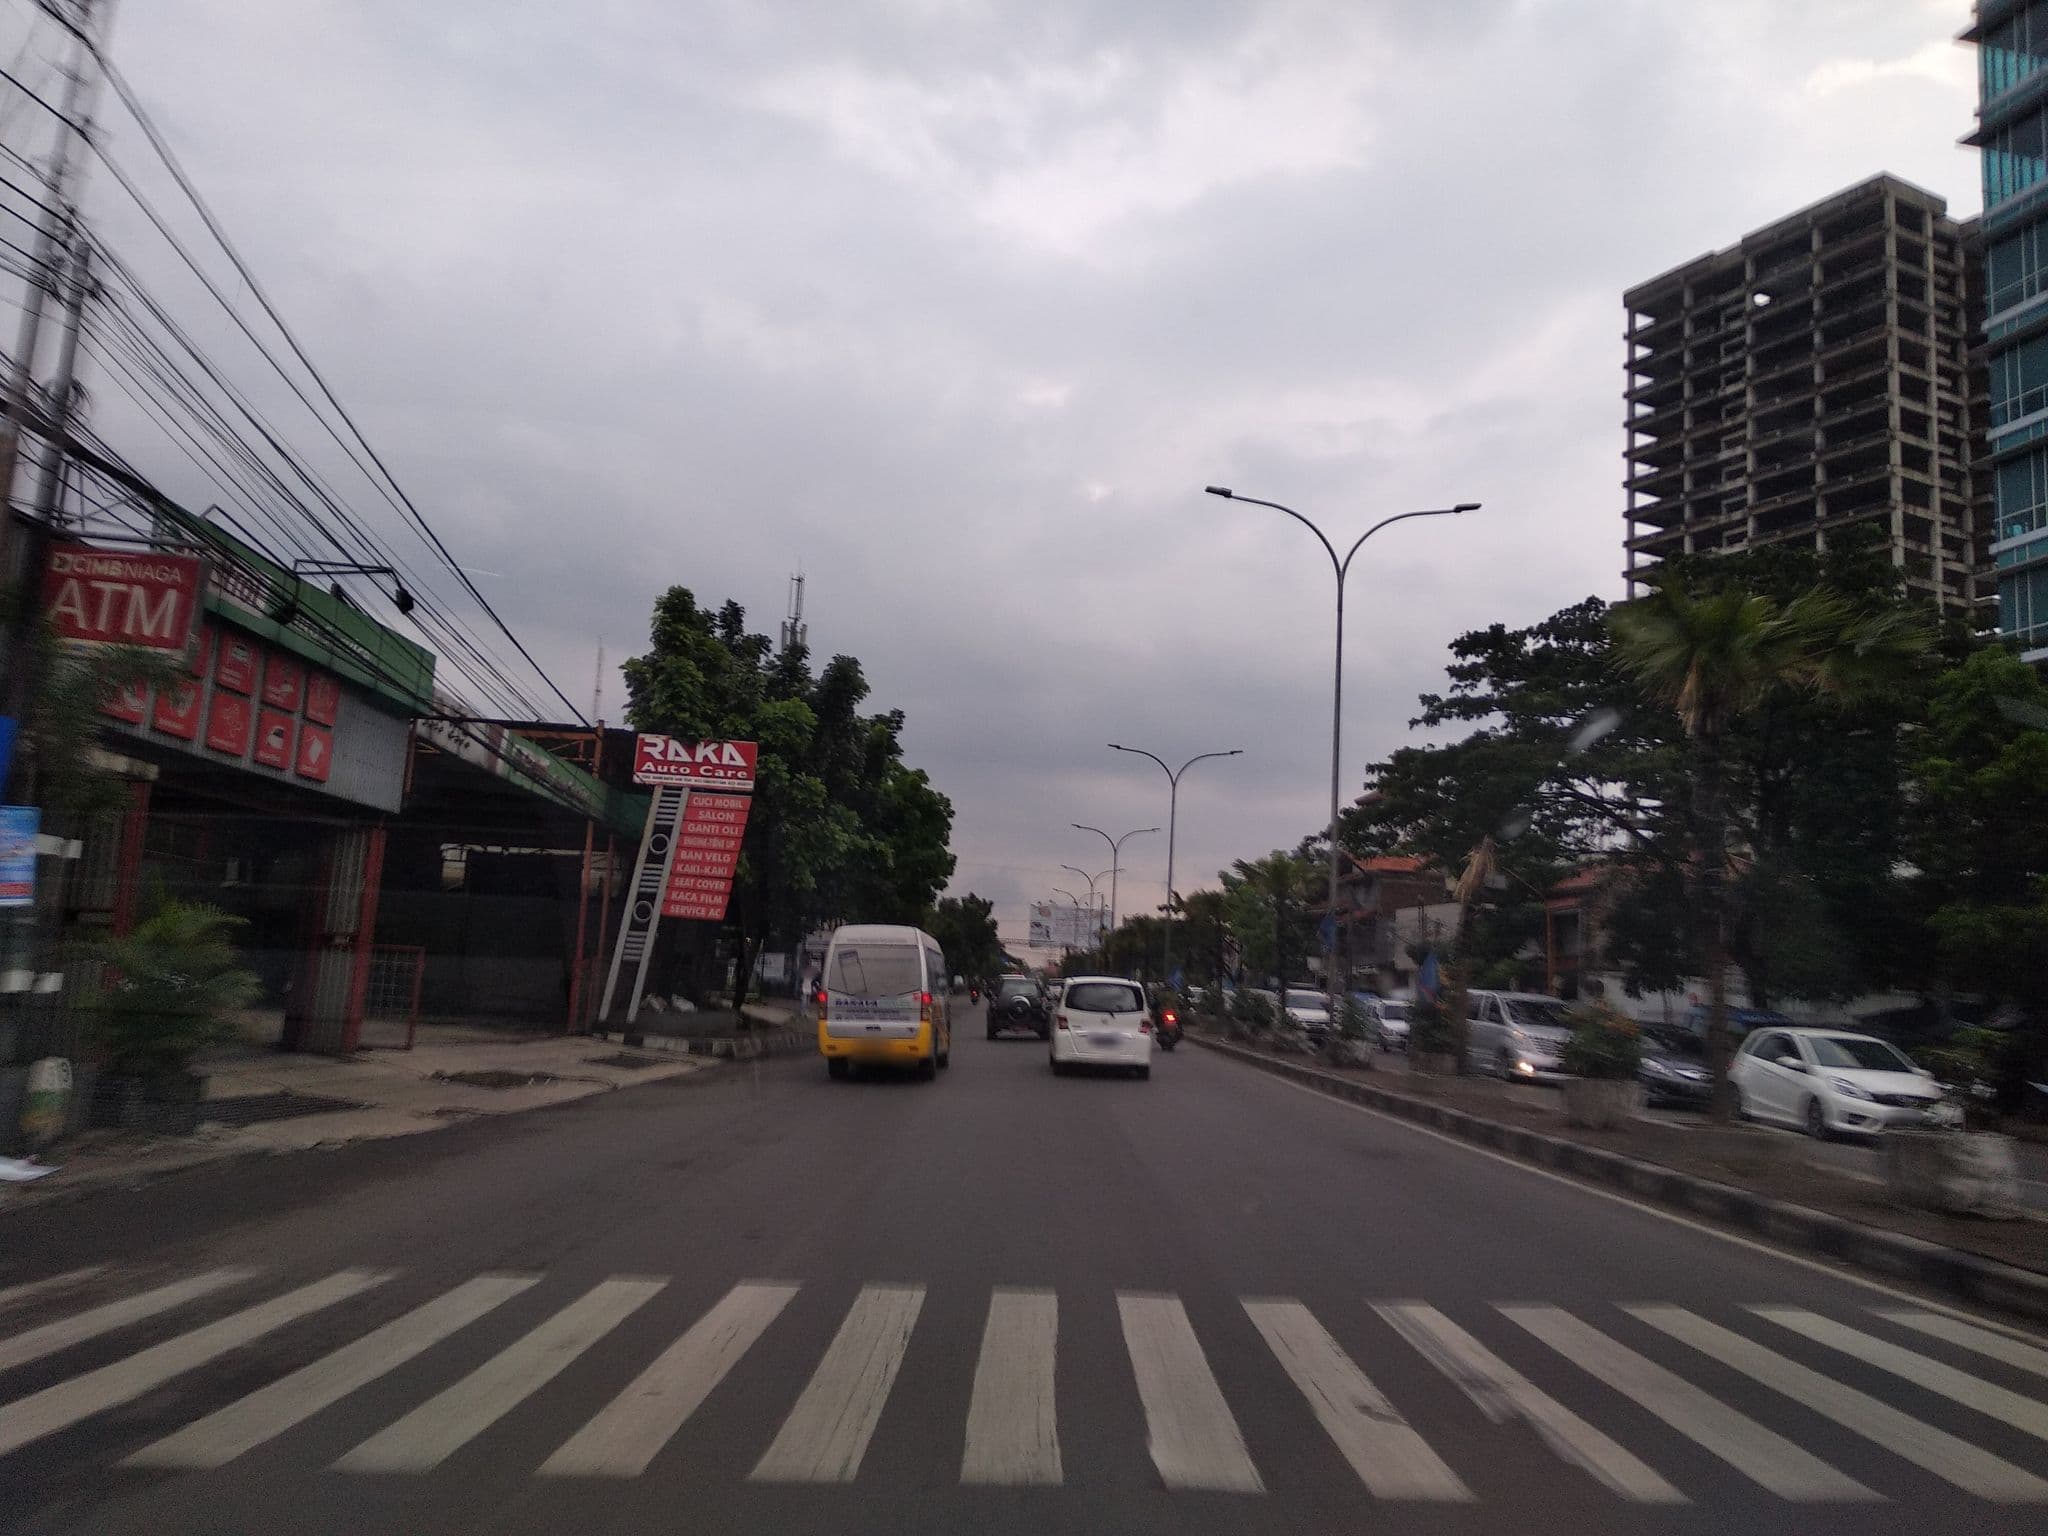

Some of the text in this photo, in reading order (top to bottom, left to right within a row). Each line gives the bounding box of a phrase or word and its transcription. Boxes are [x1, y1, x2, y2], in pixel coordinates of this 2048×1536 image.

[48, 578, 177, 638] ATM
[643, 737, 748, 766] RAKA
[641, 761, 748, 778] Auto Care
[692, 796, 744, 808] CUCI MOBIL
[698, 810, 736, 821] SALON
[687, 823, 739, 835] GANTI OLI
[680, 851, 731, 864] BAN VELG
[676, 863, 728, 876] KAKI-KAKI
[674, 877, 726, 890] SEAT COVER
[671, 891, 723, 904] KACA FILM
[670, 904, 722, 917] SERVICE AC
